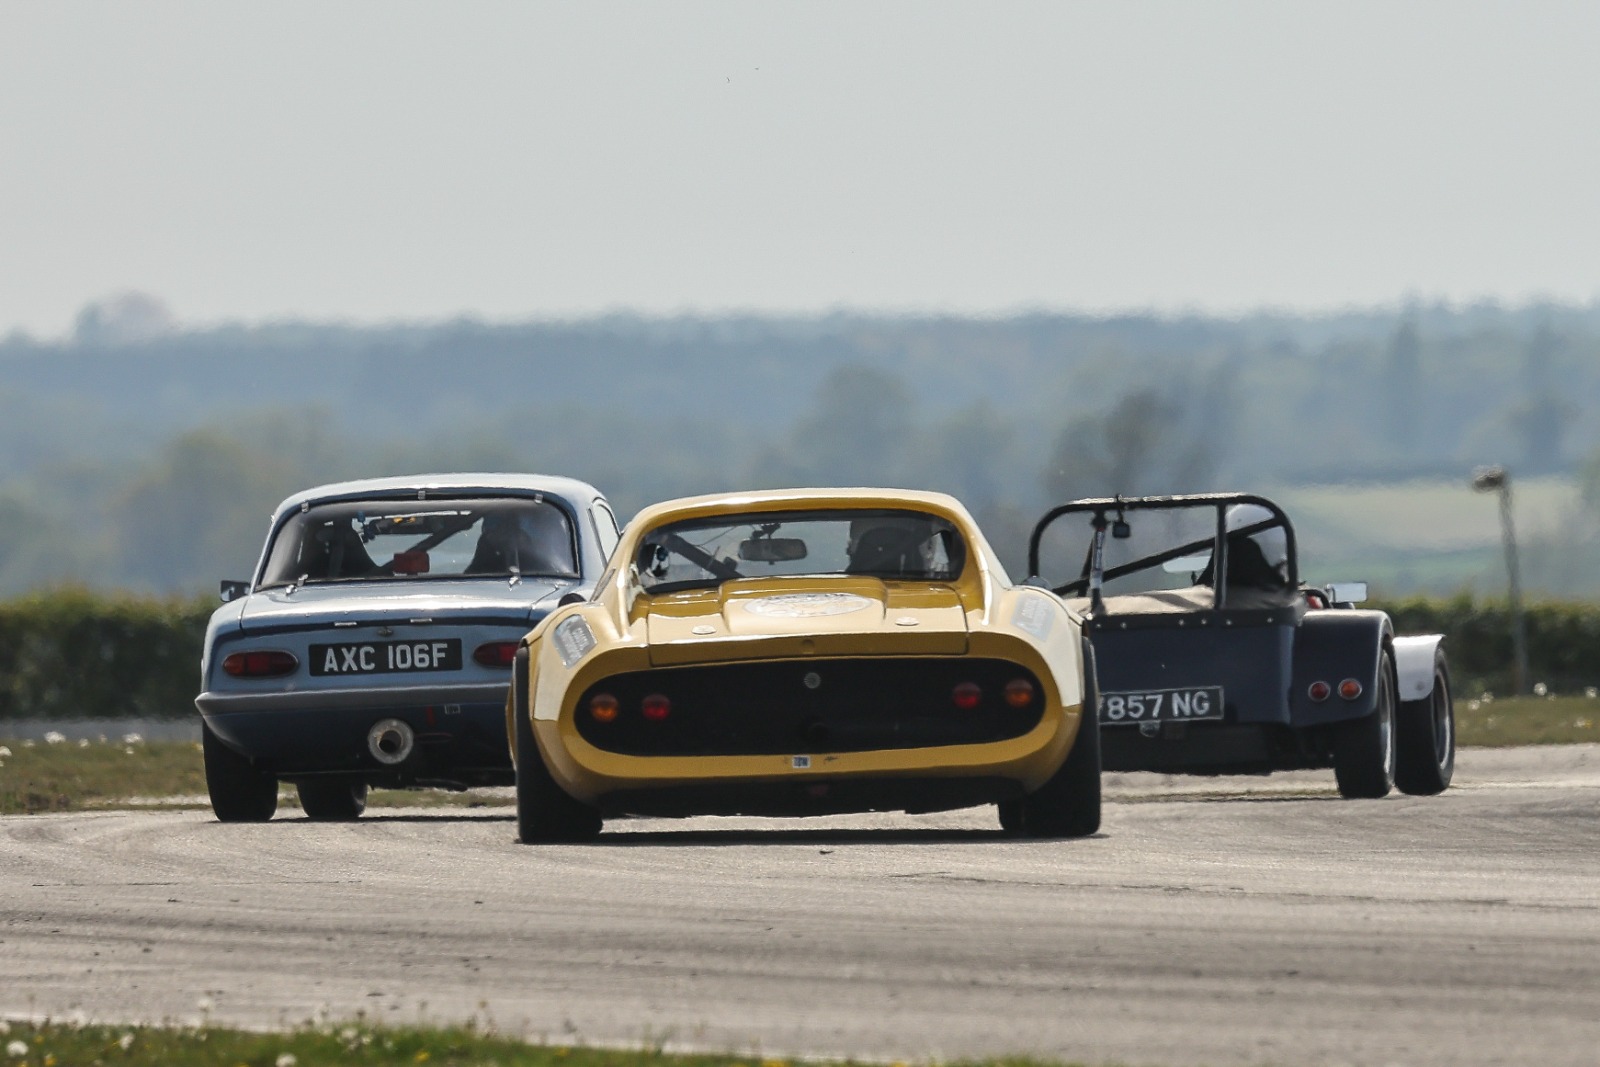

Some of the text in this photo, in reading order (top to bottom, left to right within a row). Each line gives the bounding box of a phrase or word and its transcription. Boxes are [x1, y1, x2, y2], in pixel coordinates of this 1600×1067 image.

[324, 643, 448, 672] AXC 106F
[1172, 691, 1210, 717] NG
